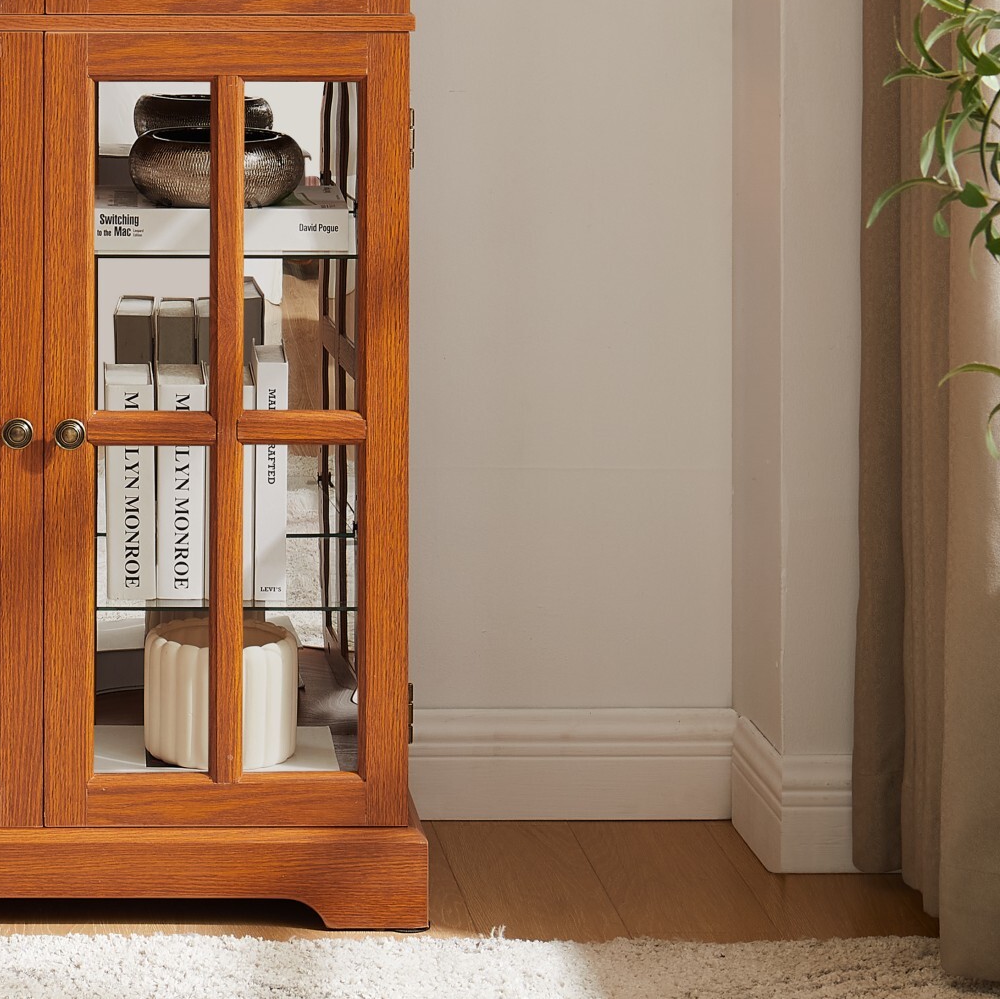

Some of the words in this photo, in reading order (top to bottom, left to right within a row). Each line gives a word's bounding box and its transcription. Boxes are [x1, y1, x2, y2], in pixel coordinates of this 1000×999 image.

[96, 229, 102, 237] to
[103, 229, 112, 237] the
[113, 226, 132, 237] Mac
[99, 213, 140, 227] Switching
[299, 223, 317, 233] David
[318, 223, 339, 234] Pogue
[267, 444, 276, 485] RAFTED
[124, 496, 141, 589] MONROE
[173, 498, 190, 590] MONROE
